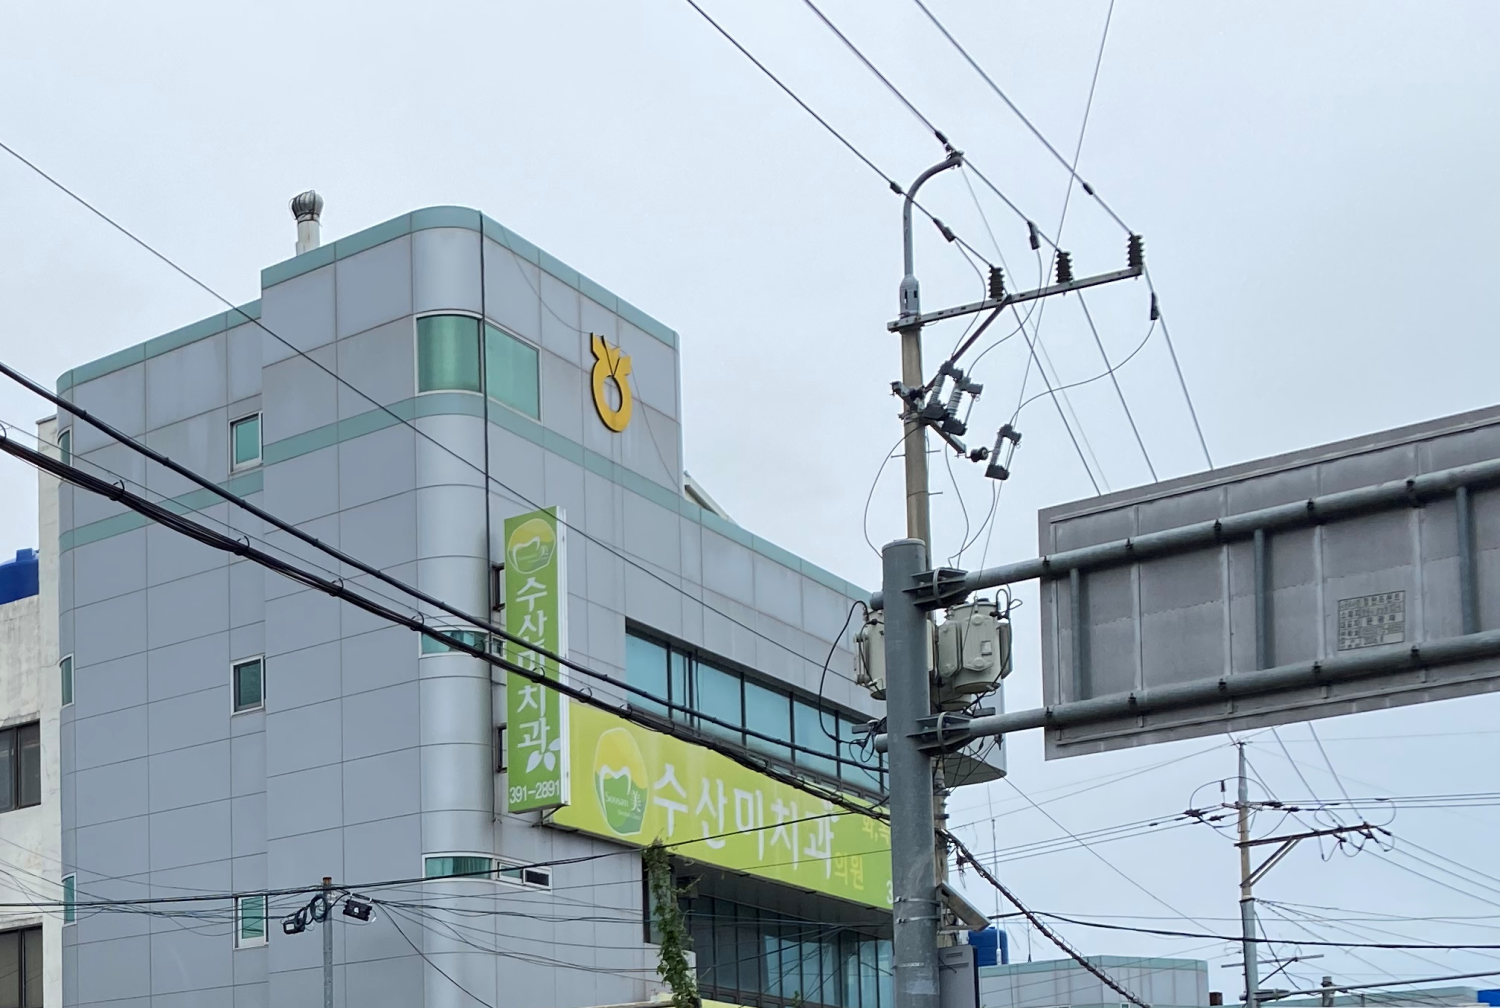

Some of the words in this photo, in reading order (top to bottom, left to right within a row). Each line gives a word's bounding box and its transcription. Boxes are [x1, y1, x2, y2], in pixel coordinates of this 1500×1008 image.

[515, 577, 551, 754] 수산미치과
[509, 780, 560, 803] 391-2891
[653, 763, 838, 880] 수산미치과
[834, 851, 865, 891] 의원
